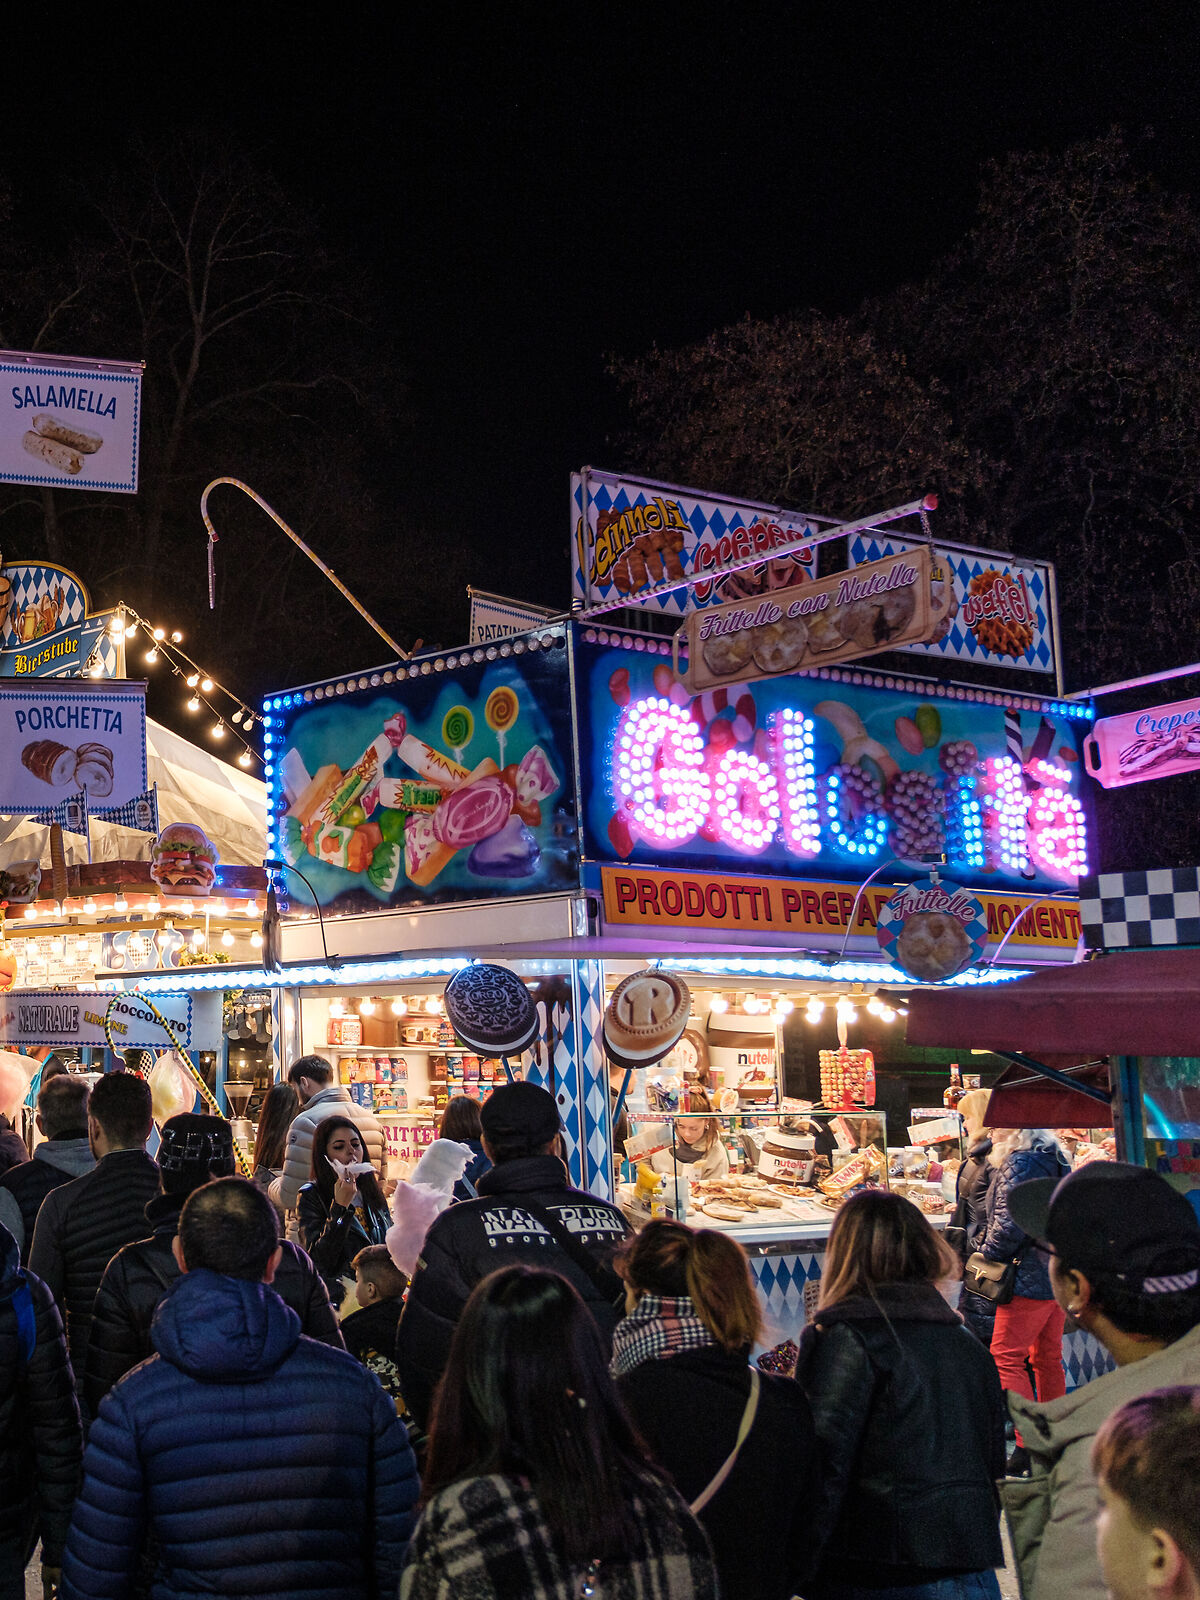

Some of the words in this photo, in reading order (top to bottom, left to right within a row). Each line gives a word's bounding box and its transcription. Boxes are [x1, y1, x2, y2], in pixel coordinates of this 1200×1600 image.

[12, 385, 117, 419] SALAMELLA
[577, 497, 692, 585] Cannoli
[700, 600, 783, 640] Frittelle
[786, 594, 828, 618] con
[834, 562, 919, 608] Nutella
[14, 637, 79, 677] Bierstube
[15, 705, 123, 734] PORCHETTA
[615, 876, 773, 921] PRODOTTI
[891, 889, 976, 922] Frittelle
[471, 990, 502, 1001] OREO
[17, 1005, 80, 1033] NATURALE
[84, 1010, 129, 1035] LIMNE
[401, 1146, 410, 1158] al
[774, 1158, 808, 1170] nutella
[831, 1160, 864, 1185] TWIX
